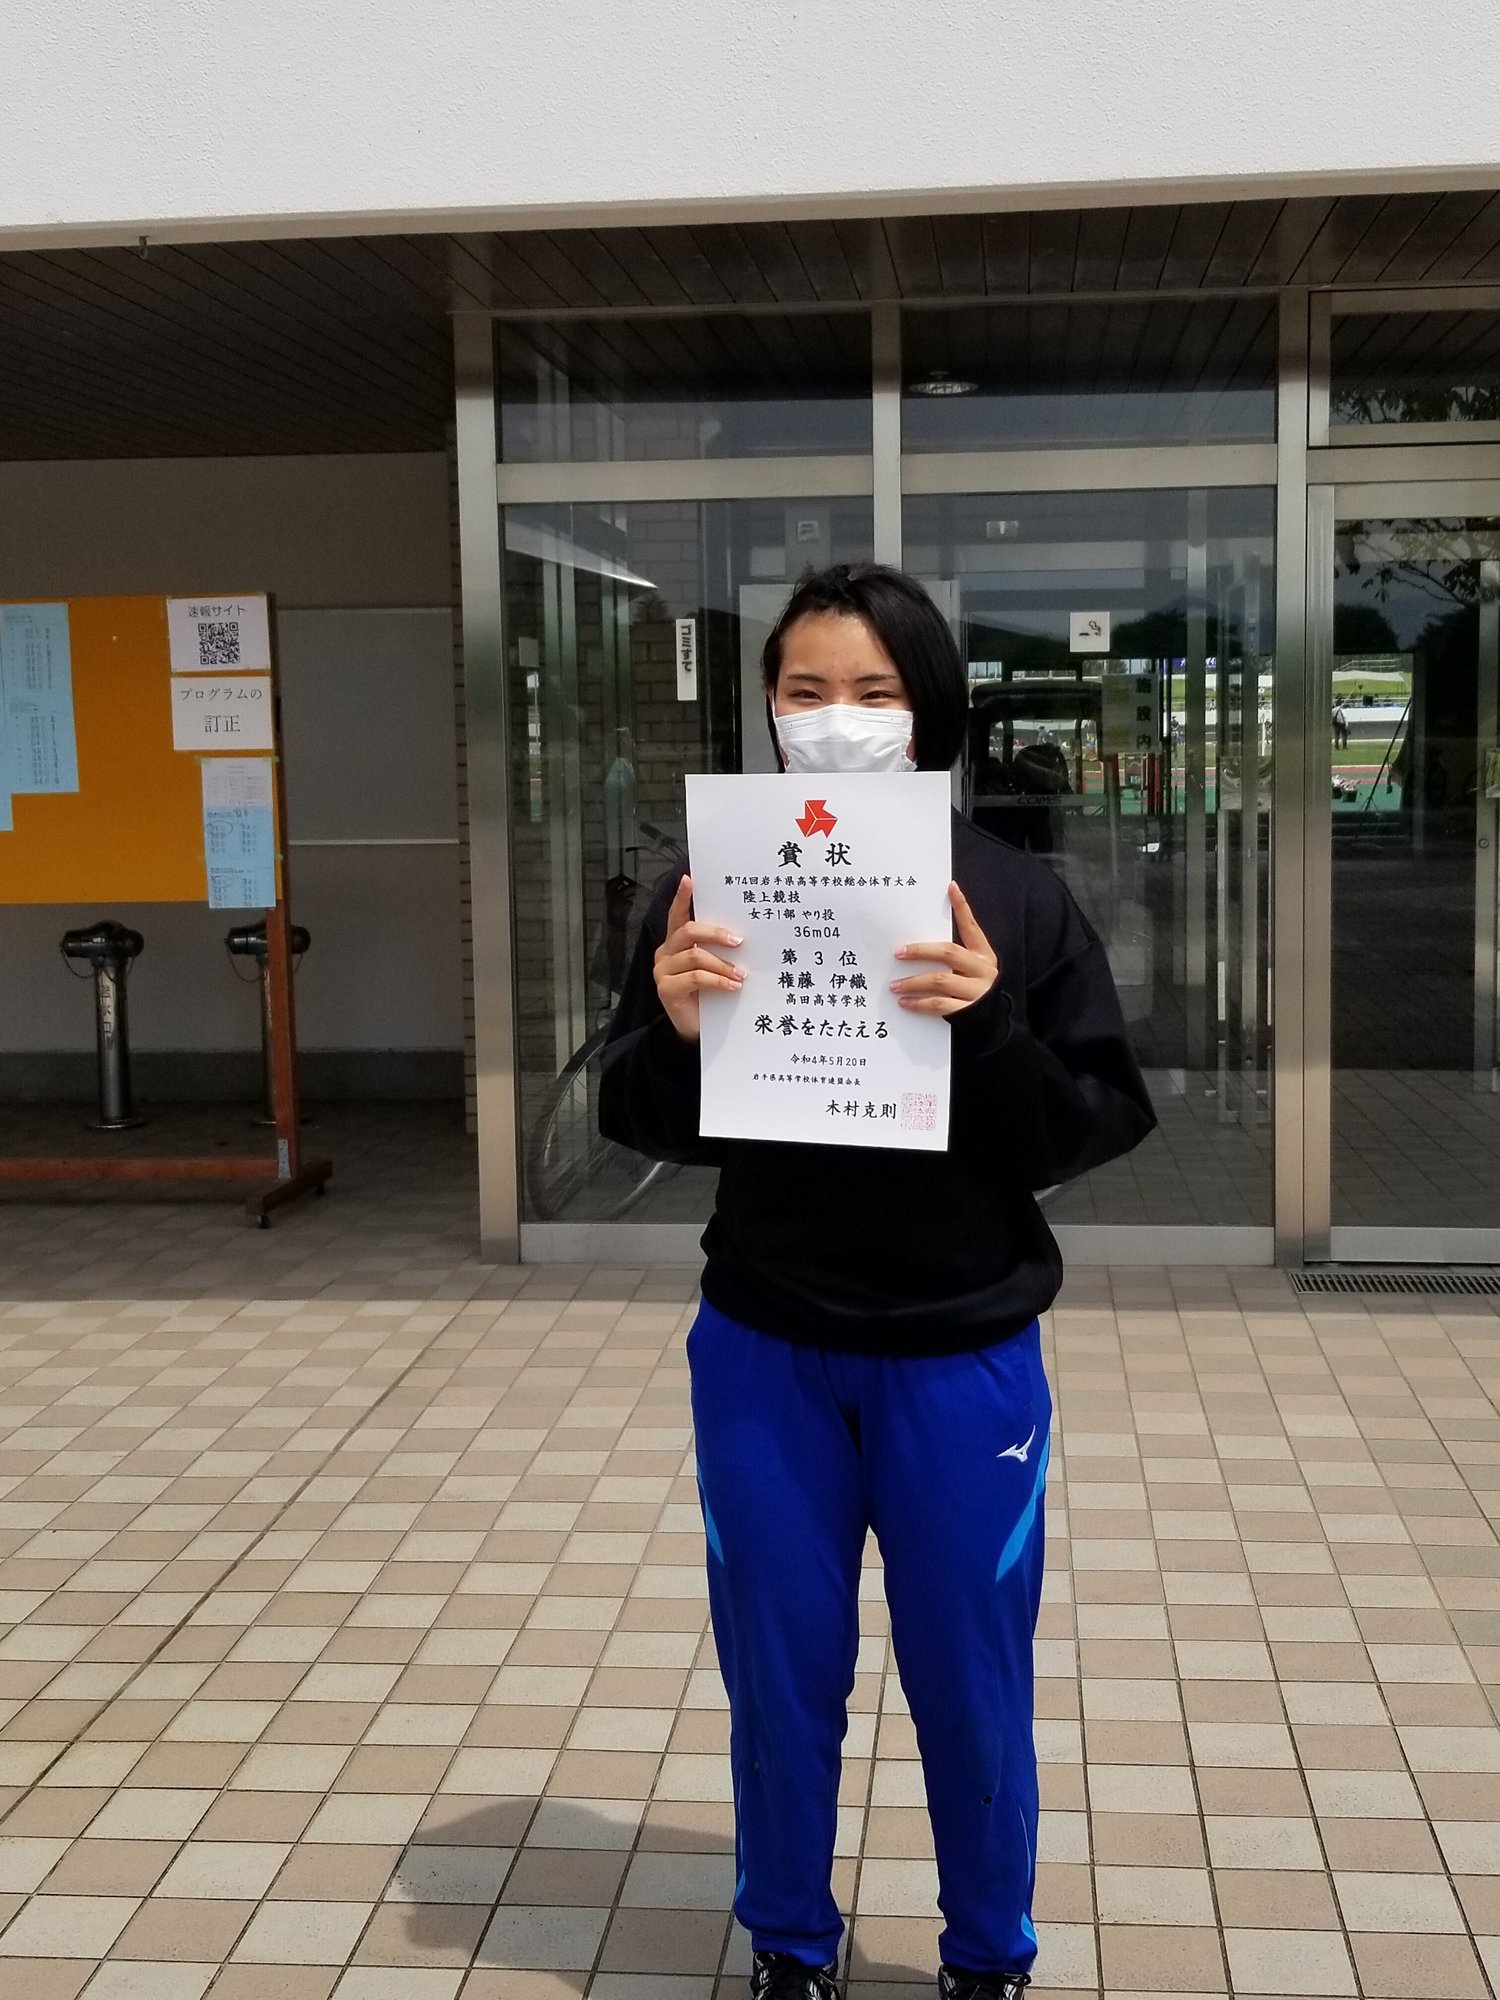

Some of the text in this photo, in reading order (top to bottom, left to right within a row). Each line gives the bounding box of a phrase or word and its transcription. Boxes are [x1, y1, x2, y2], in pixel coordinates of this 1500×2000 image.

[188, 604, 246, 617] 速報サイト
[680, 624, 693, 673] ゴミすて
[180, 688, 263, 701] プログラムの
[204, 714, 242, 732] 訂正
[743, 889, 802, 904] 陸上競技
[801, 909, 836, 922] やり投
[794, 925, 841, 939] 36m04
[754, 1014, 889, 1039] 栄誉をたたえる
[790, 1053, 867, 1067] 令和4年5月20日
[825, 1099, 897, 1120] 木村克則
